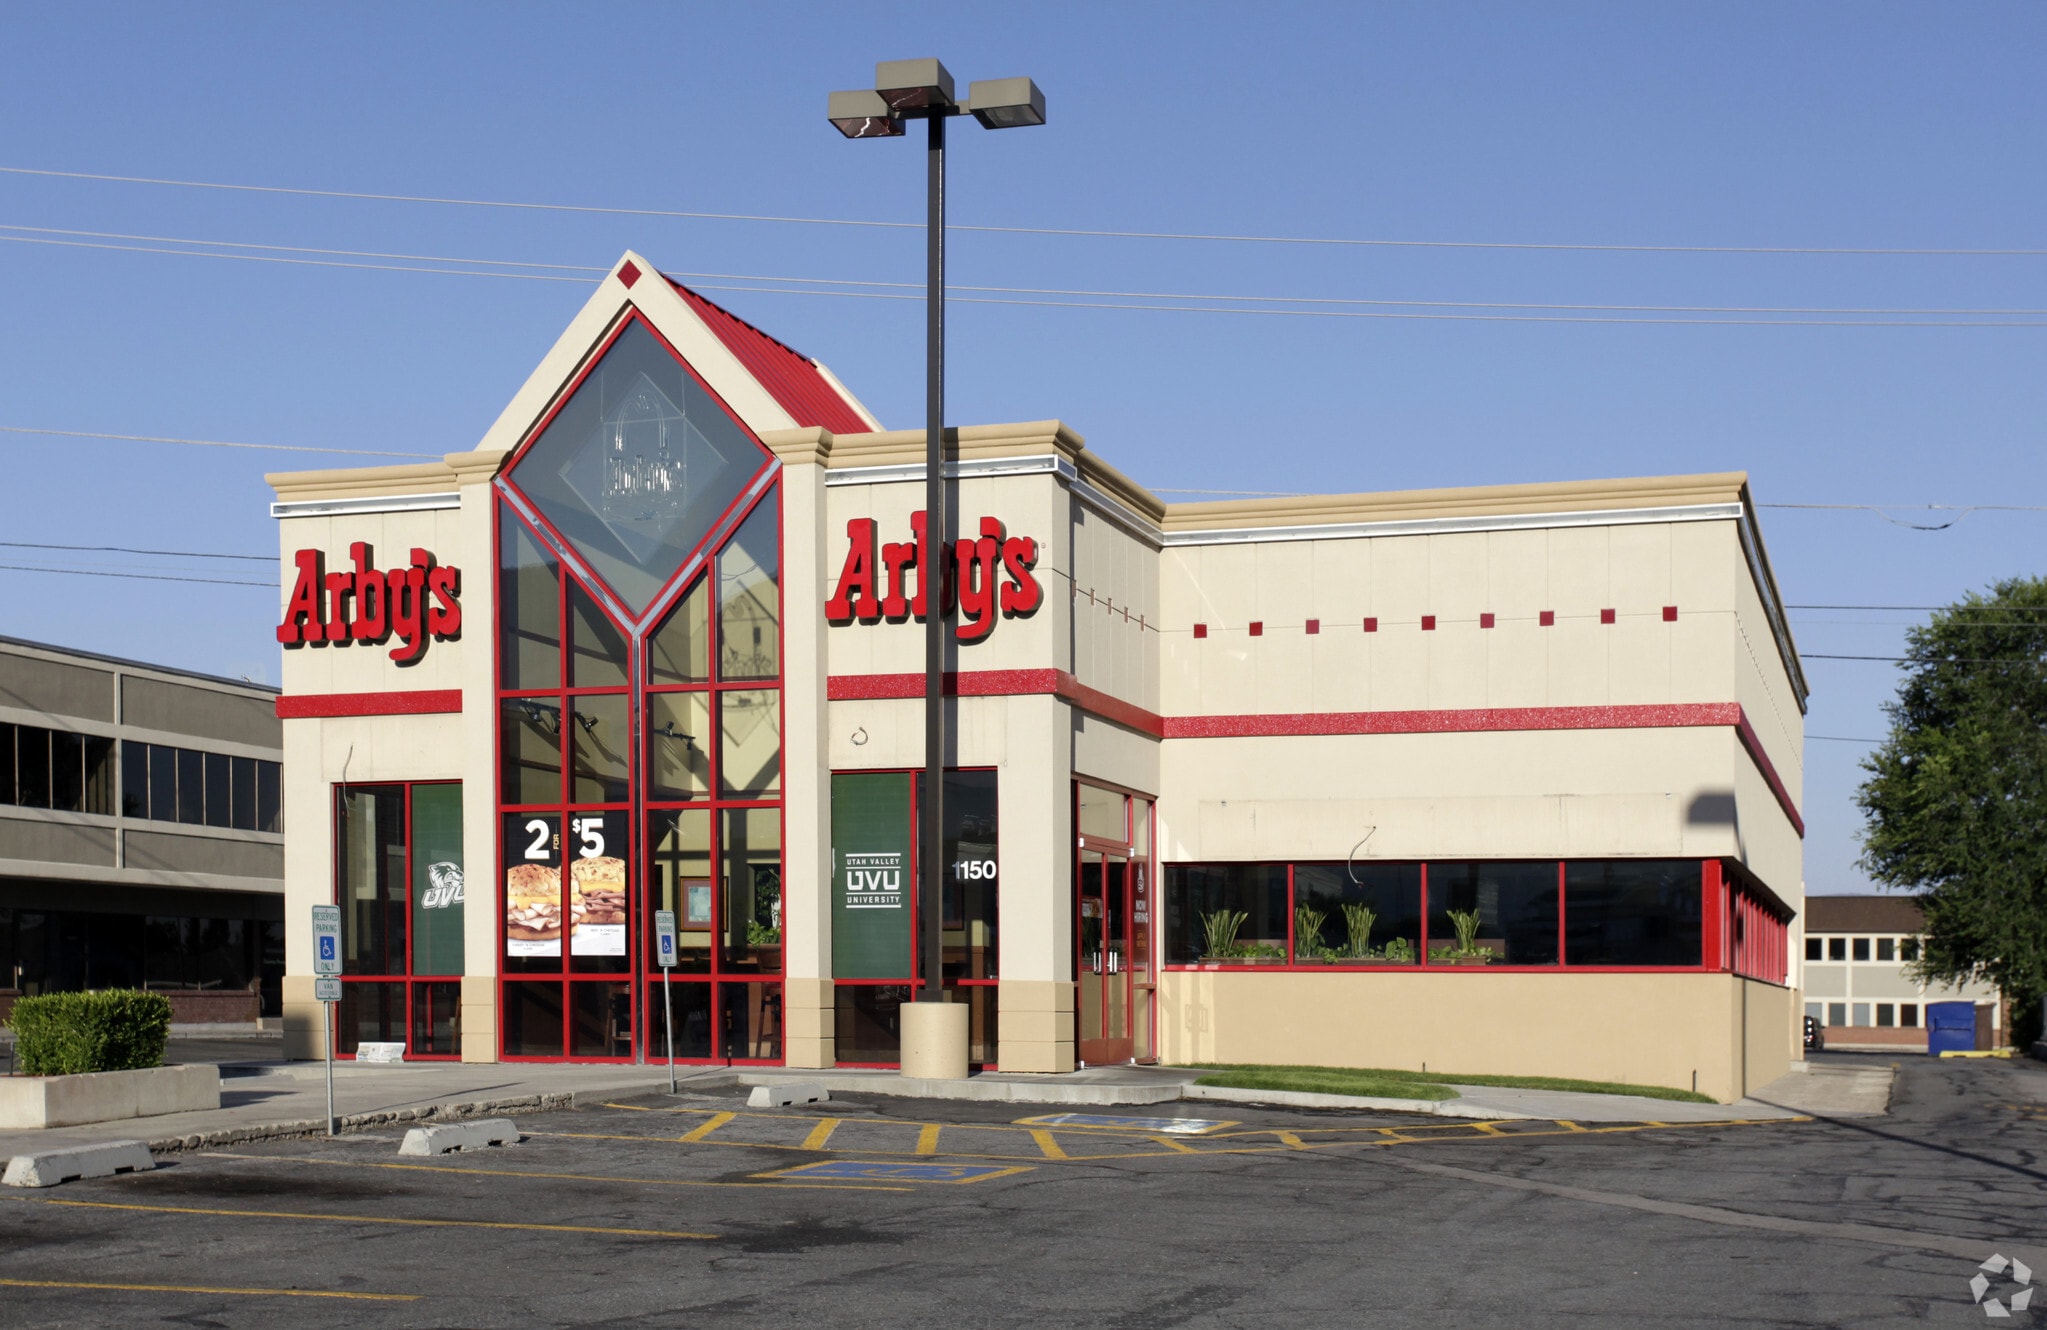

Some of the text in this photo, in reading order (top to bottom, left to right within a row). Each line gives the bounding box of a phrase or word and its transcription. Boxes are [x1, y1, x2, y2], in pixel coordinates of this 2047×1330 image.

[276, 541, 461, 665] Arby's
[524, 819, 550, 859] 2
[552, 833, 560, 850] FOR
[846, 857, 900, 866] UTAH VALLEY
[952, 860, 997, 880] 1150
[846, 870, 900, 891] UVU
[846, 895, 900, 904] UNIVERSITY
[313, 911, 338, 921] RESERVED
[316, 923, 337, 933] PARKING
[321, 962, 335, 971] ONLY
